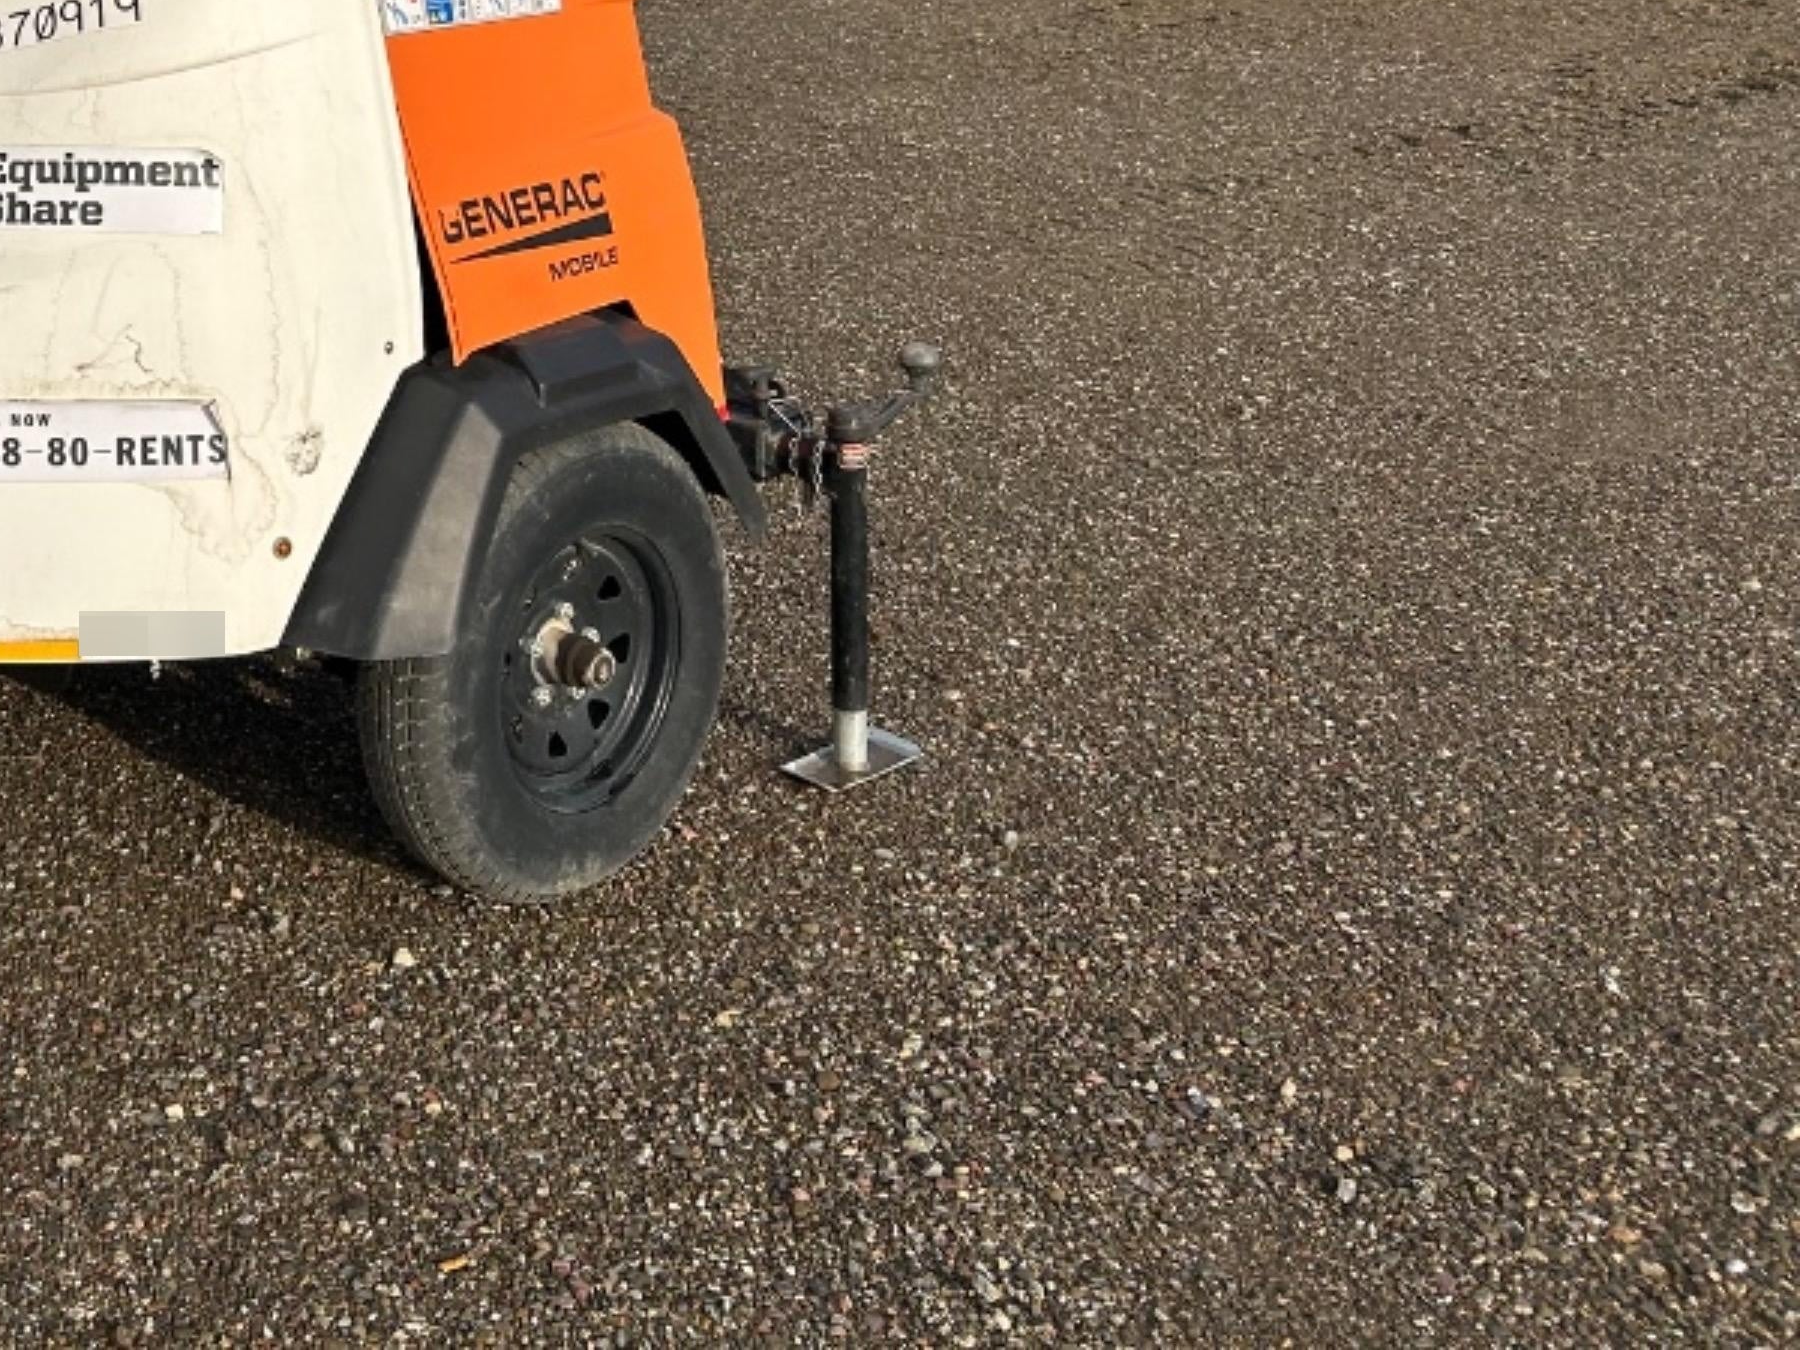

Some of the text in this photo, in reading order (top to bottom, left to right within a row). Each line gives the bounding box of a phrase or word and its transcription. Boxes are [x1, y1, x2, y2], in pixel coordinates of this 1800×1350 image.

[438, 172, 606, 243] GENERAC
[549, 247, 618, 281] MOBILE
[11, 414, 51, 427] NOW
